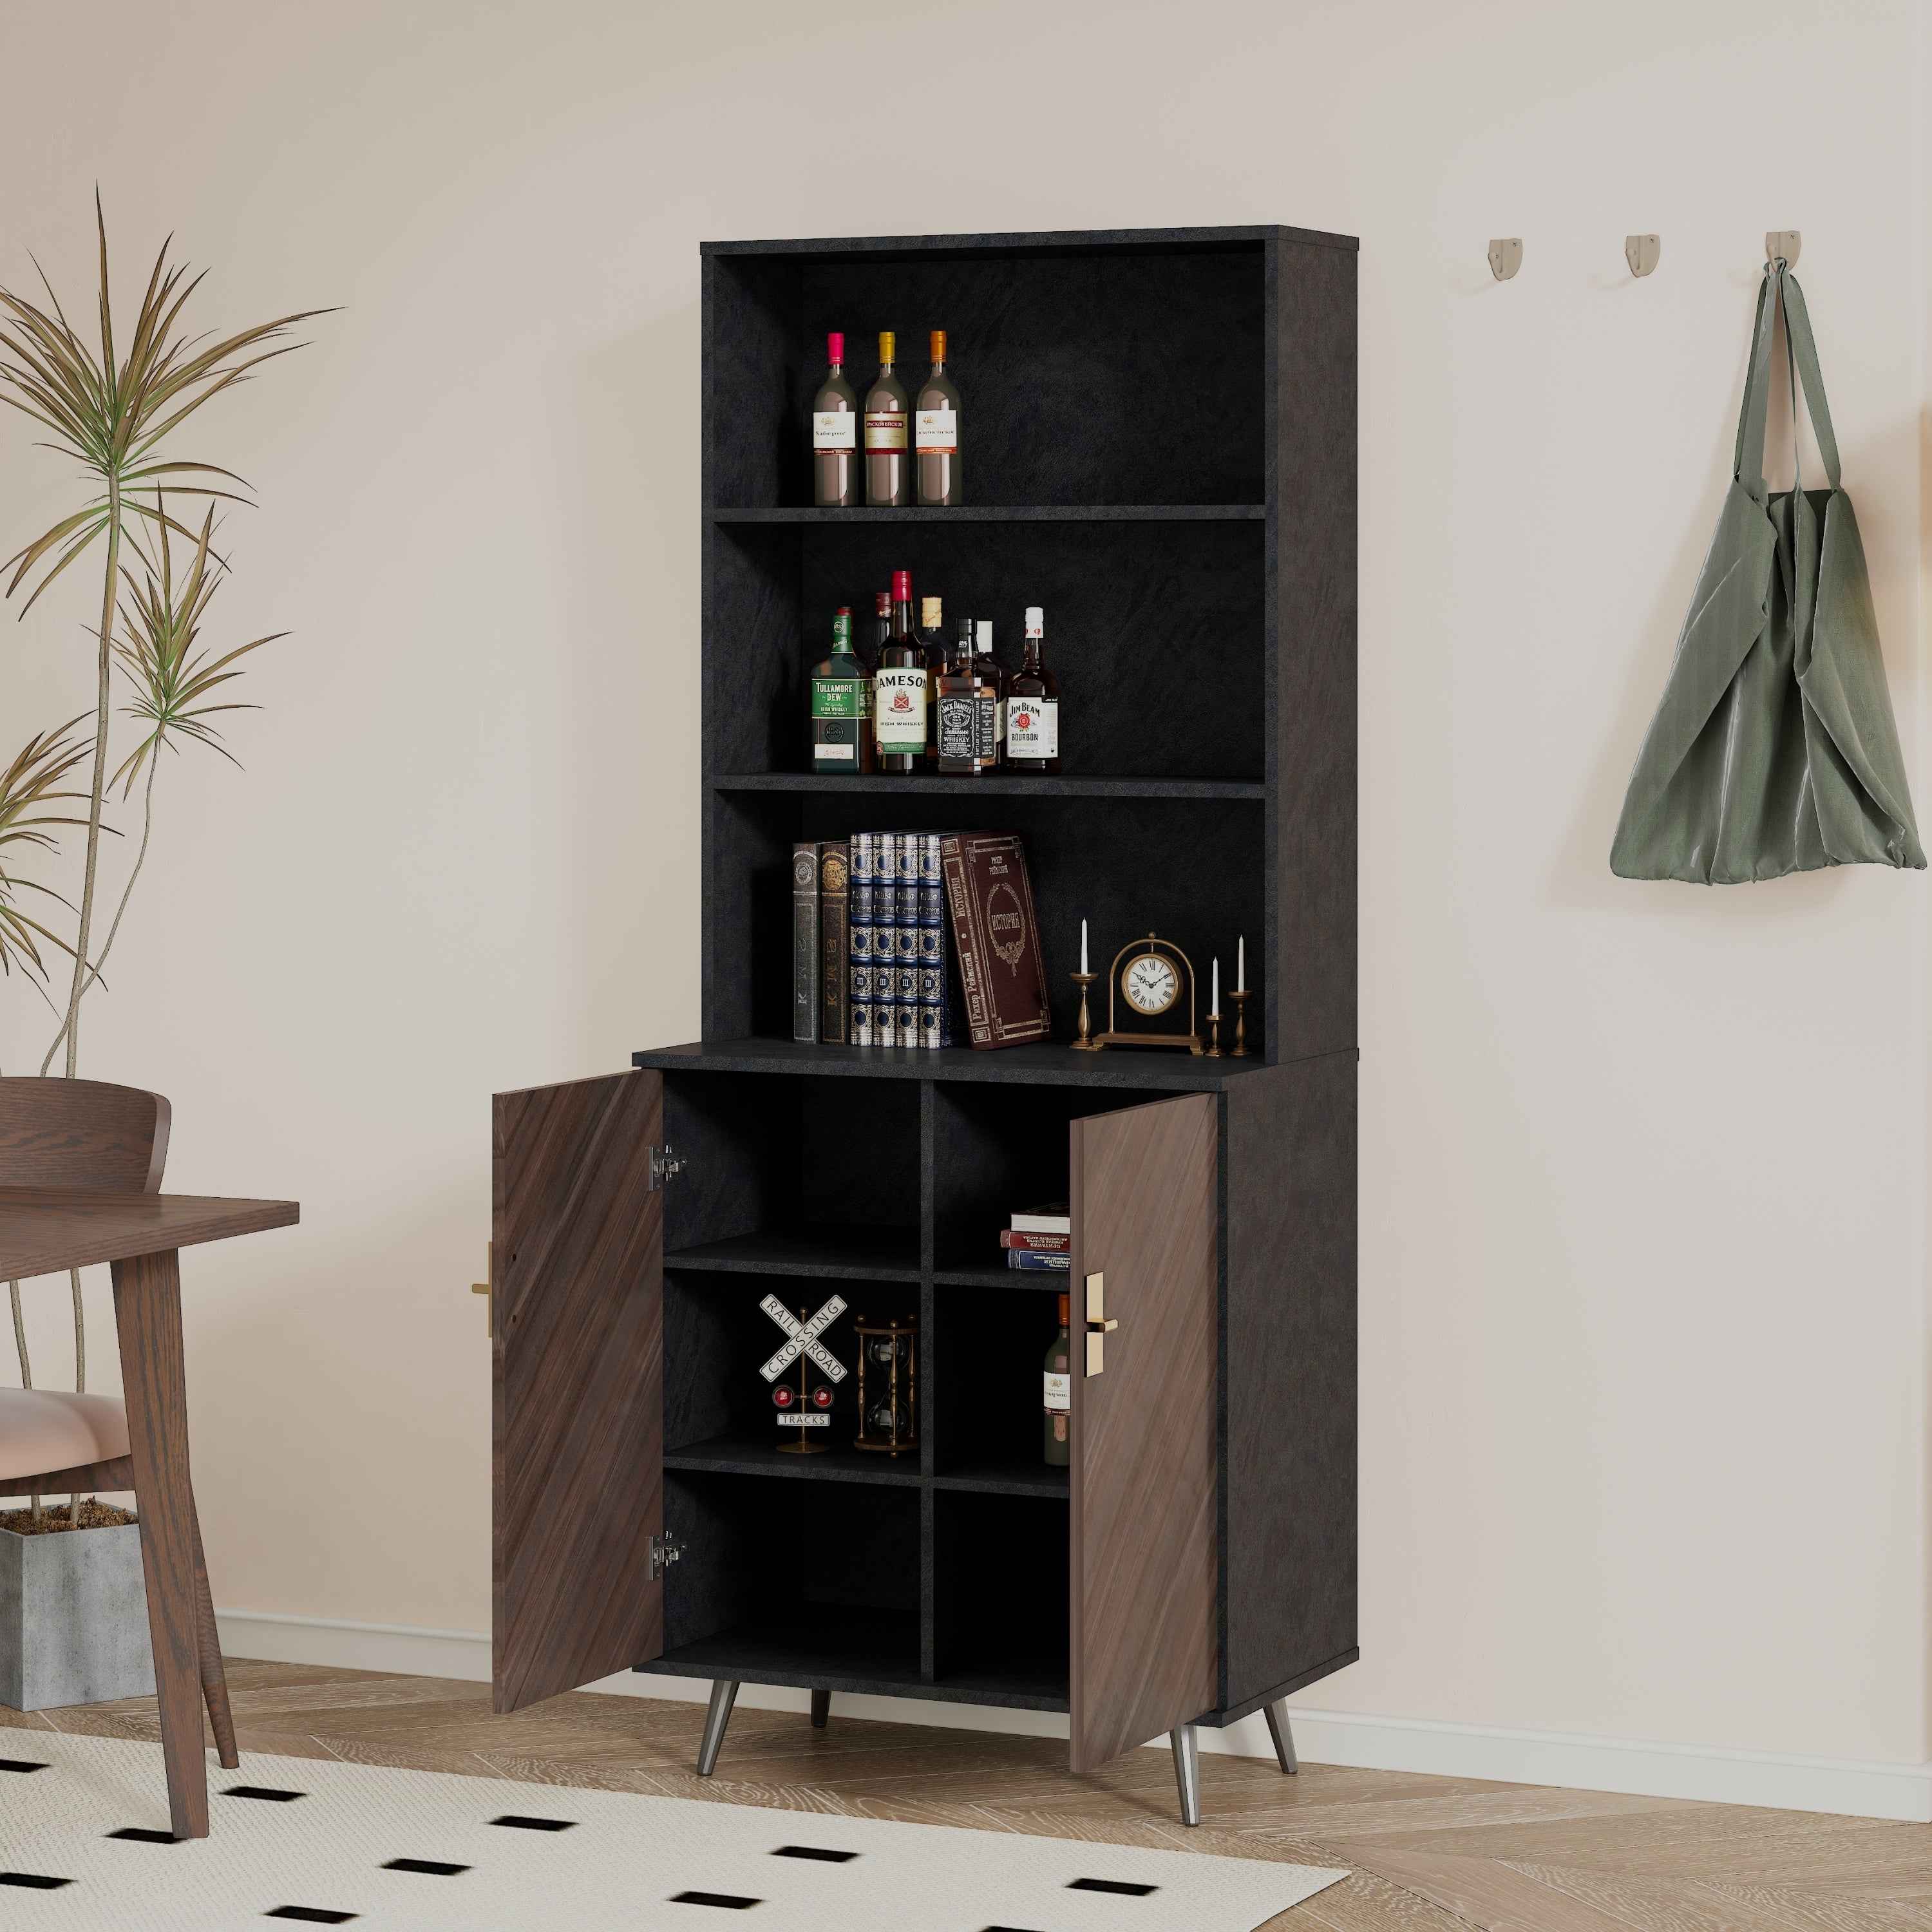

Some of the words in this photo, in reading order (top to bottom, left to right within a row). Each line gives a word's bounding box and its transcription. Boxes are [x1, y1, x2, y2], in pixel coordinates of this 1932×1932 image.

[816, 682, 853, 693] TULLAMORE
[1010, 705, 1021, 717] JIM
[1022, 702, 1040, 717] BEAM
[991, 913, 1021, 931] ИСТОРИЯ
[767, 1300, 795, 1331] RAIL
[808, 1343, 841, 1376] ROAD
[768, 1303, 839, 1374] CROSSING
[782, 1416, 825, 1425] TRACKS
